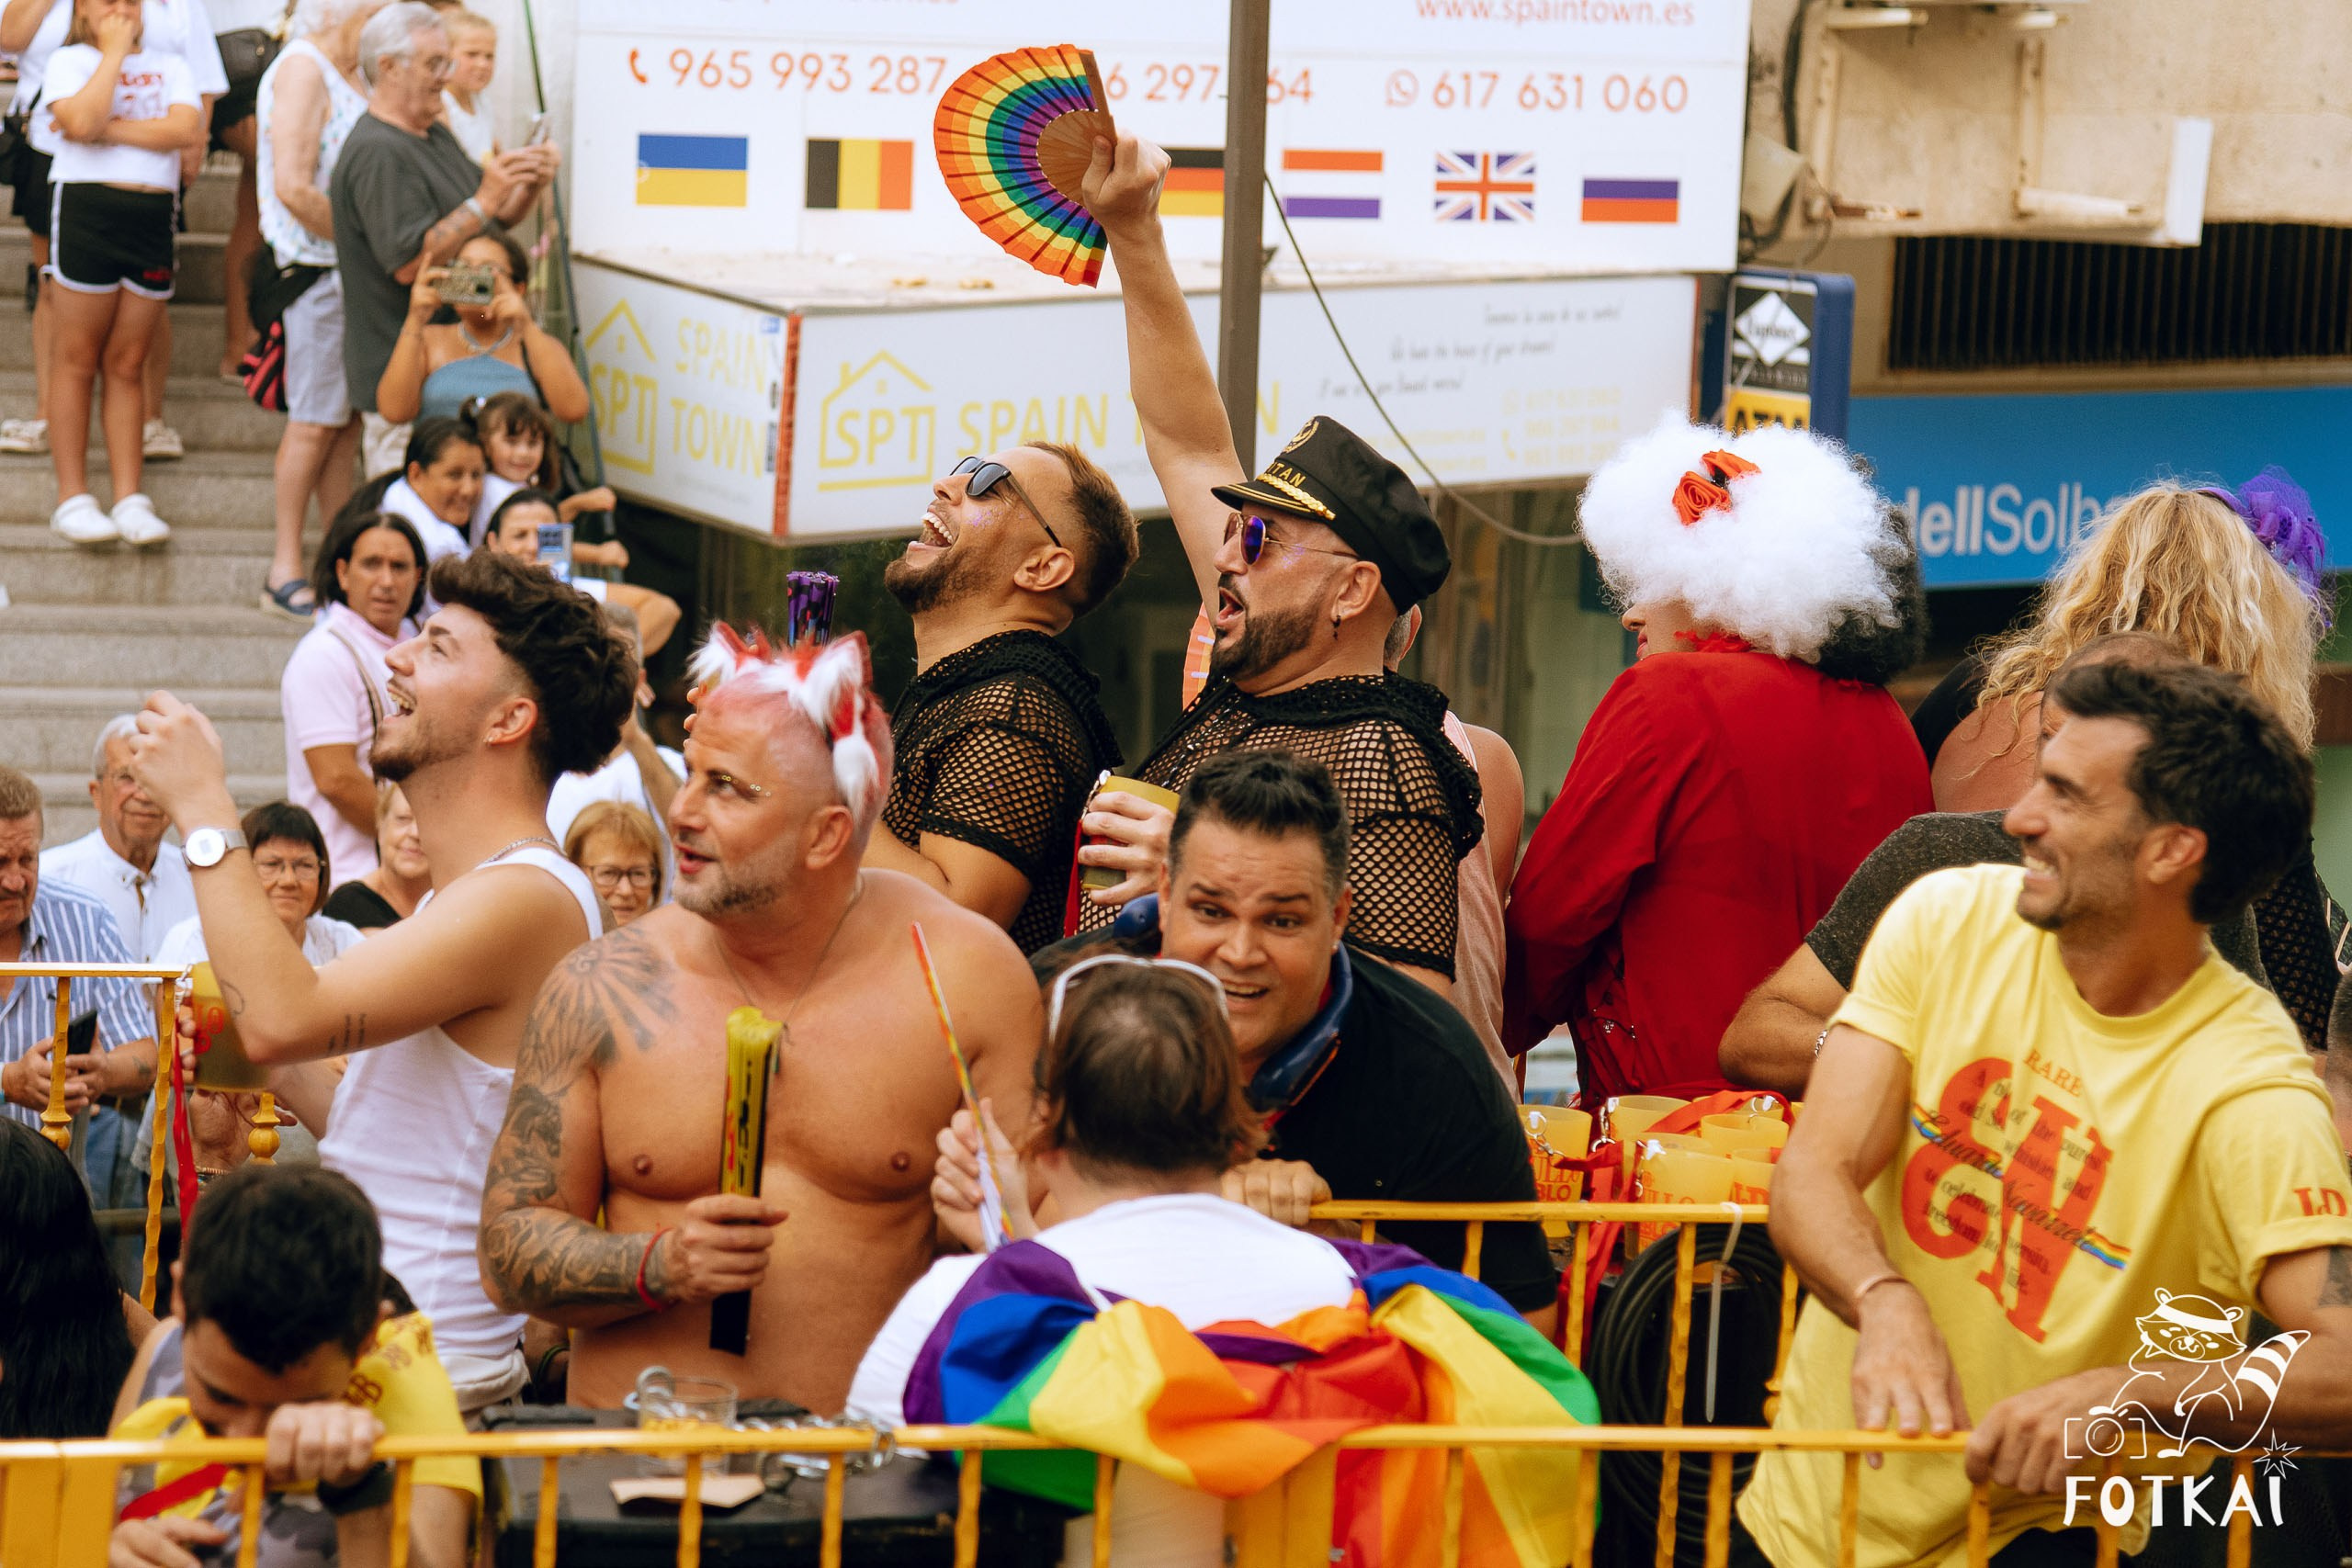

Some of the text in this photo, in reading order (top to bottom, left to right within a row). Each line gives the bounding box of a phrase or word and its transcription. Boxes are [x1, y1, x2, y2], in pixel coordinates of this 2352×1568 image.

[668, 48, 948, 96] 965 993 287
[1144, 62, 1221, 102] 297
[1267, 67, 1314, 105] 64
[1432, 70, 1690, 114] 617 631 060
[675, 316, 768, 395] SPAIN
[591, 362, 653, 445] SPT
[670, 396, 766, 479] TOWN
[836, 404, 932, 469] SPT
[956, 393, 1109, 457] SPAIN
[1267, 461, 1306, 487] ITAN
[2023, 1048, 2082, 1097] RARE
